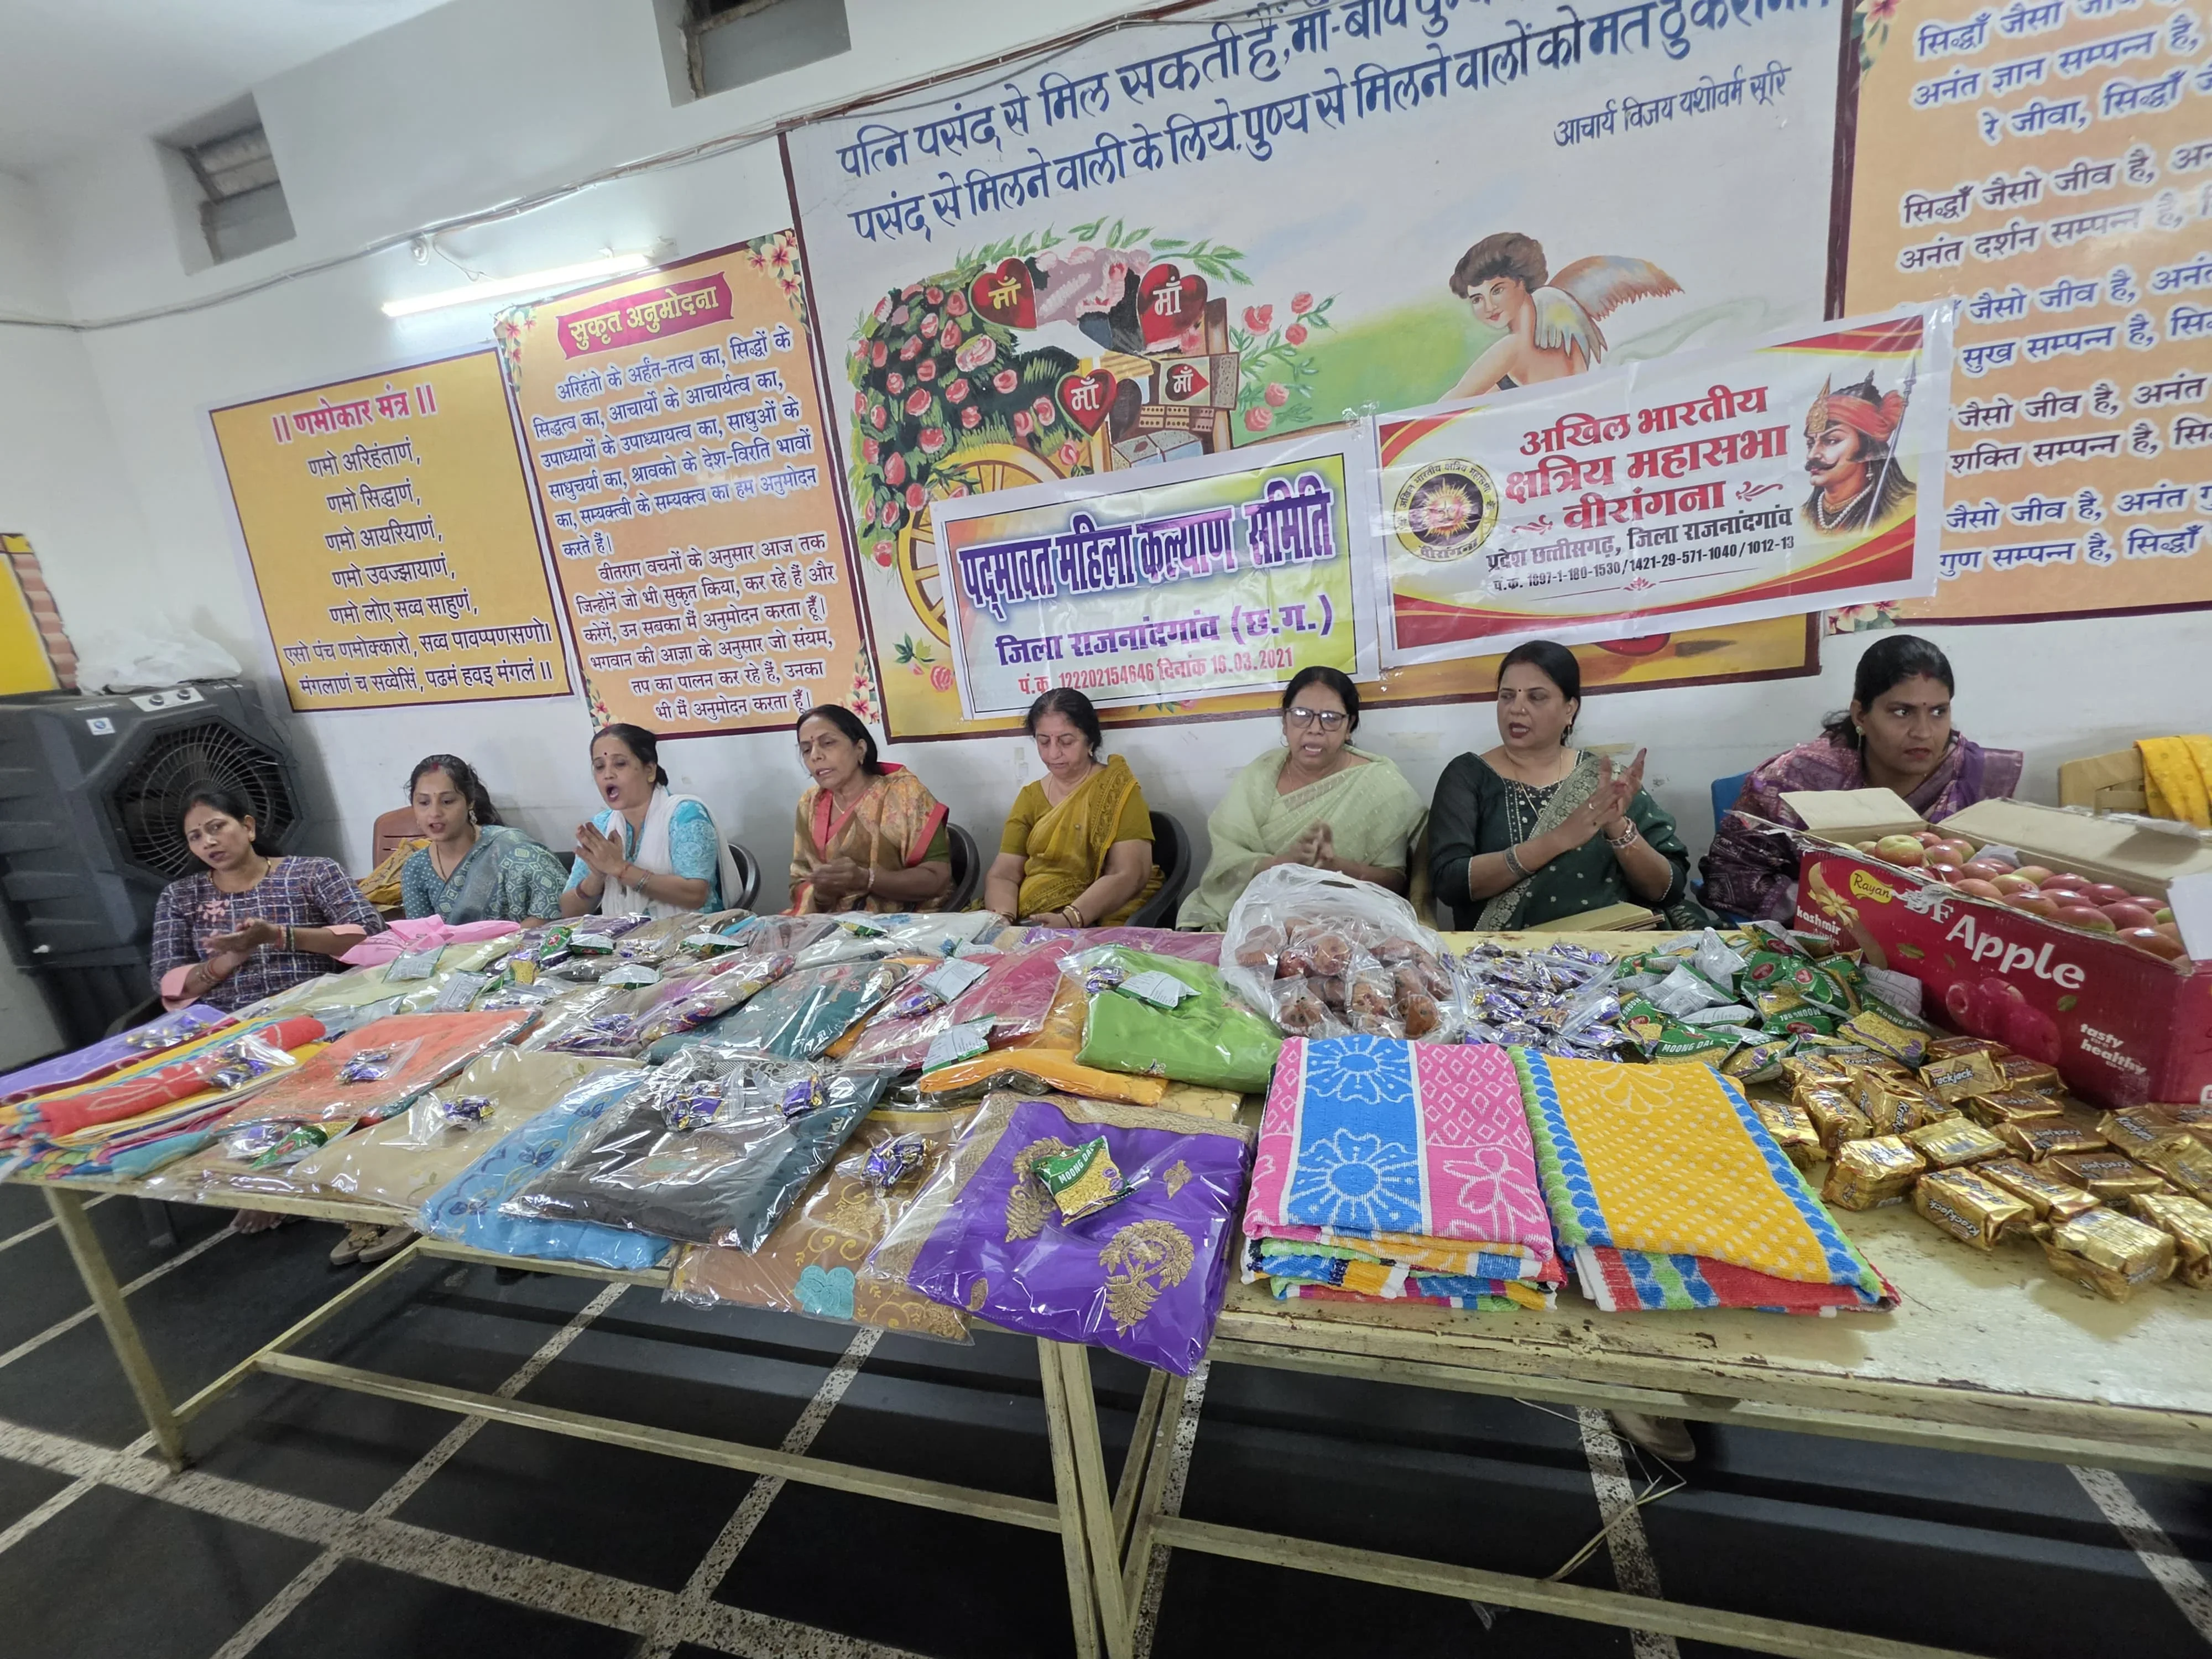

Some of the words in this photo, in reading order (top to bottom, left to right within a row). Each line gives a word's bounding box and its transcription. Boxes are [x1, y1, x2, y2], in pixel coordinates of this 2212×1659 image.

[1000, 84, 1030, 135] से
[1036, 72, 1109, 127] मिल
[1116, 21, 1243, 104] सकती
[1915, 70, 1980, 105] अनंत
[1993, 58, 2046, 88] ज्ञान
[2059, 32, 2156, 69] सम्पन्न
[930, 171, 962, 226] से
[966, 148, 1051, 216] मिलने
[1052, 132, 1127, 191] वाली
[1129, 123, 1164, 171] के
[1312, 67, 1346, 129] से
[1352, 42, 1454, 118] मिलने
[1455, 19, 1536, 92] वालों
[1536, 6, 1585, 69] को
[1586, 1, 1659, 55] मत
[1554, 99, 1616, 147] आचार्य
[1623, 96, 1677, 132] विजय
[1750, 60, 1791, 106] सूरि
[988, 275, 1021, 310] माँ
[1152, 276, 1182, 316] माँ
[568, 312, 623, 350] सुकृत
[627, 287, 719, 332] अनुमोदना
[558, 371, 602, 399] अरिहंतो
[607, 366, 622, 387] के
[699, 348, 726, 368] का,
[730, 331, 768, 360] सिद्धों
[773, 326, 790, 348] के
[1172, 366, 1193, 393] माँ
[294, 398, 372, 435] णमोकार
[377, 383, 408, 416] मंत्र
[533, 416, 576, 438] सिद्धत्व
[581, 410, 604, 429] का,
[664, 387, 679, 408] के
[686, 374, 750, 404] आचार्यत्व
[755, 371, 782, 390] का,
[1071, 376, 1099, 410] माँ
[541, 439, 597, 467] उपाध्यायों
[601, 435, 615, 455] के
[620, 424, 692, 451] उपाध्यायत्व
[696, 419, 722, 437] का,
[727, 400, 776, 432] साधुओं
[782, 396, 799, 418] के
[1520, 414, 1630, 456] अखिल
[1637, 385, 1768, 434] भारतीय
[308, 451, 339, 476] णमो
[1505, 455, 1616, 504] क्षत्रिय
[1627, 425, 1790, 479] महासभा
[1950, 443, 2022, 473] शक्ति
[2034, 435, 2120, 462] सम्पन्न
[2132, 423, 2158, 454] है,
[327, 487, 358, 513] णमो
[1563, 481, 1725, 530] वीरांगना
[1947, 502, 2000, 528] जैसो
[2011, 498, 2067, 521] जीव
[2078, 491, 2101, 521] है,
[2117, 483, 2188, 512] अनंत
[325, 526, 356, 551] णमो
[562, 535, 591, 556] करते
[1056, 515, 1135, 593] महिला
[1136, 508, 1235, 581] कल्याण
[1244, 476, 1334, 566] समिति
[1486, 549, 1527, 572] प्रदेश
[1627, 525, 1678, 550] जिला
[1682, 504, 1792, 541] राजनांदगांव
[1940, 551, 1982, 576] गुण
[1993, 543, 2076, 566] सम्पन्न
[2088, 533, 2111, 562] है,
[332, 564, 363, 587] णमो
[329, 601, 360, 624] णमो
[362, 598, 393, 623] लोए
[393, 599, 424, 618] सव्व
[283, 641, 310, 666] एसो
[312, 636, 336, 660] पंच
[419, 634, 448, 651] सव्व
[995, 634, 1063, 665] जिला
[1067, 610, 1219, 658] राजनांदगांव
[299, 672, 352, 695] मंगलाणं
[354, 676, 368, 692] च
[425, 664, 458, 687] पढमं
[461, 666, 493, 686] हवइ
[495, 658, 535, 682] मंगलं
[632, 680, 649, 692] तप
[655, 678, 672, 690] का
[678, 674, 713, 688] पालन
[718, 671, 740, 684] कर
[744, 669, 760, 683] रहे
[785, 662, 822, 677] उनका
[1059, 664, 1154, 690] 122202154646
[1157, 654, 1206, 681] दिनांक
[656, 702, 671, 718] भी
[677, 698, 687, 716] मैं
[694, 700, 747, 720] अनुमोदन
[752, 696, 786, 710] करता
[1853, 873, 1889, 898] Rayan
[1797, 906, 1841, 935] kashmir
[1946, 914, 2085, 989] Apple
[1876, 1006, 1903, 1025] MOONG
[1661, 1042, 1694, 1053] MOONG
[2080, 1024, 2124, 1048] tasty
[2080, 1039, 2147, 1075] healthy
[1058, 1159, 1084, 1183] MOONG
[1928, 1198, 1980, 1237] Krackjack
